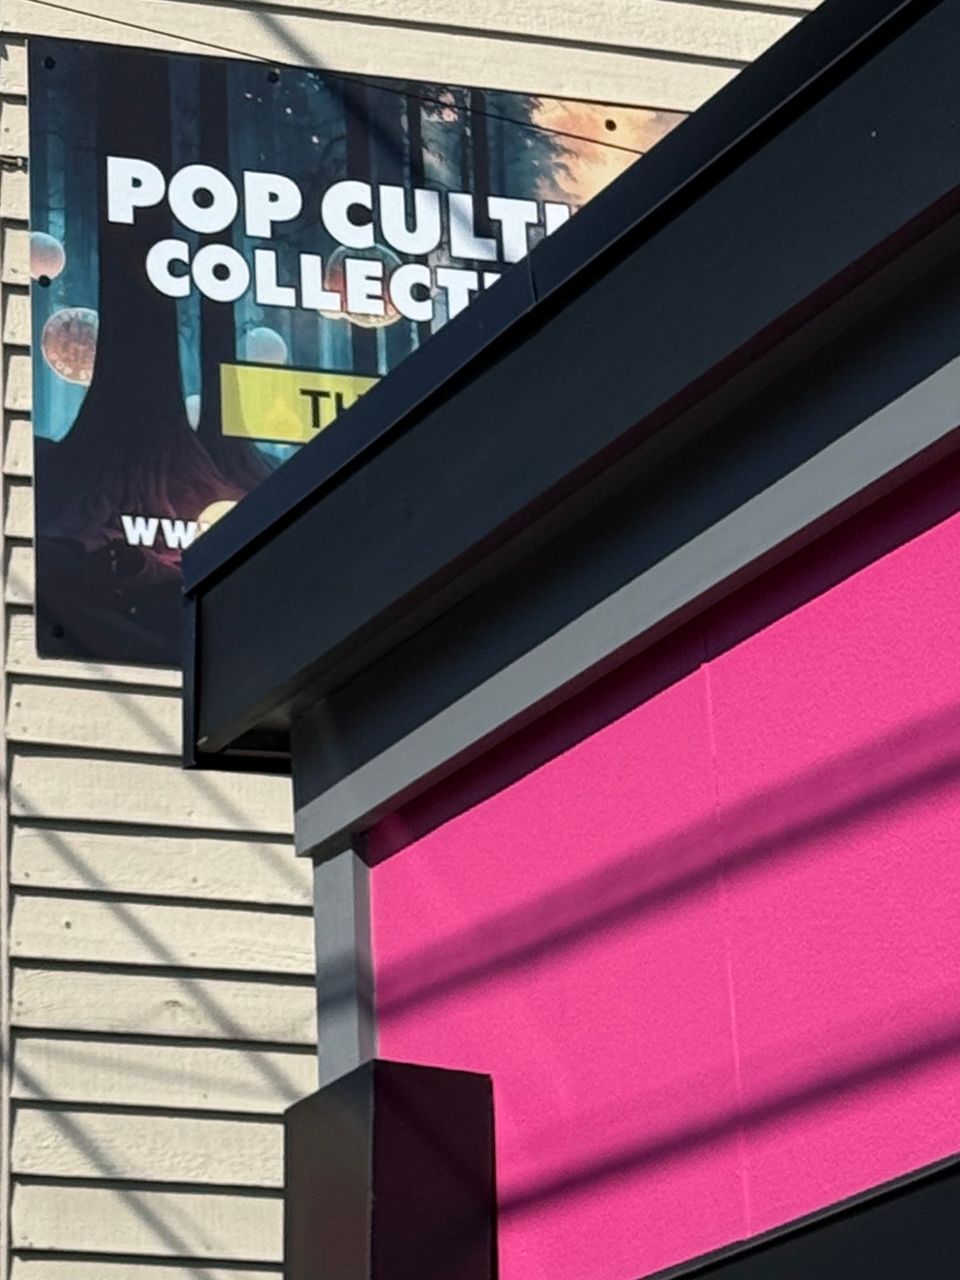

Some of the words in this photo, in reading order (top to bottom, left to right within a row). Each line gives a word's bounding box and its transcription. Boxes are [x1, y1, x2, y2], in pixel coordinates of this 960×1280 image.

[106, 155, 303, 238] POP
[321, 180, 571, 264] CULT
[145, 238, 502, 323] COLLECT
